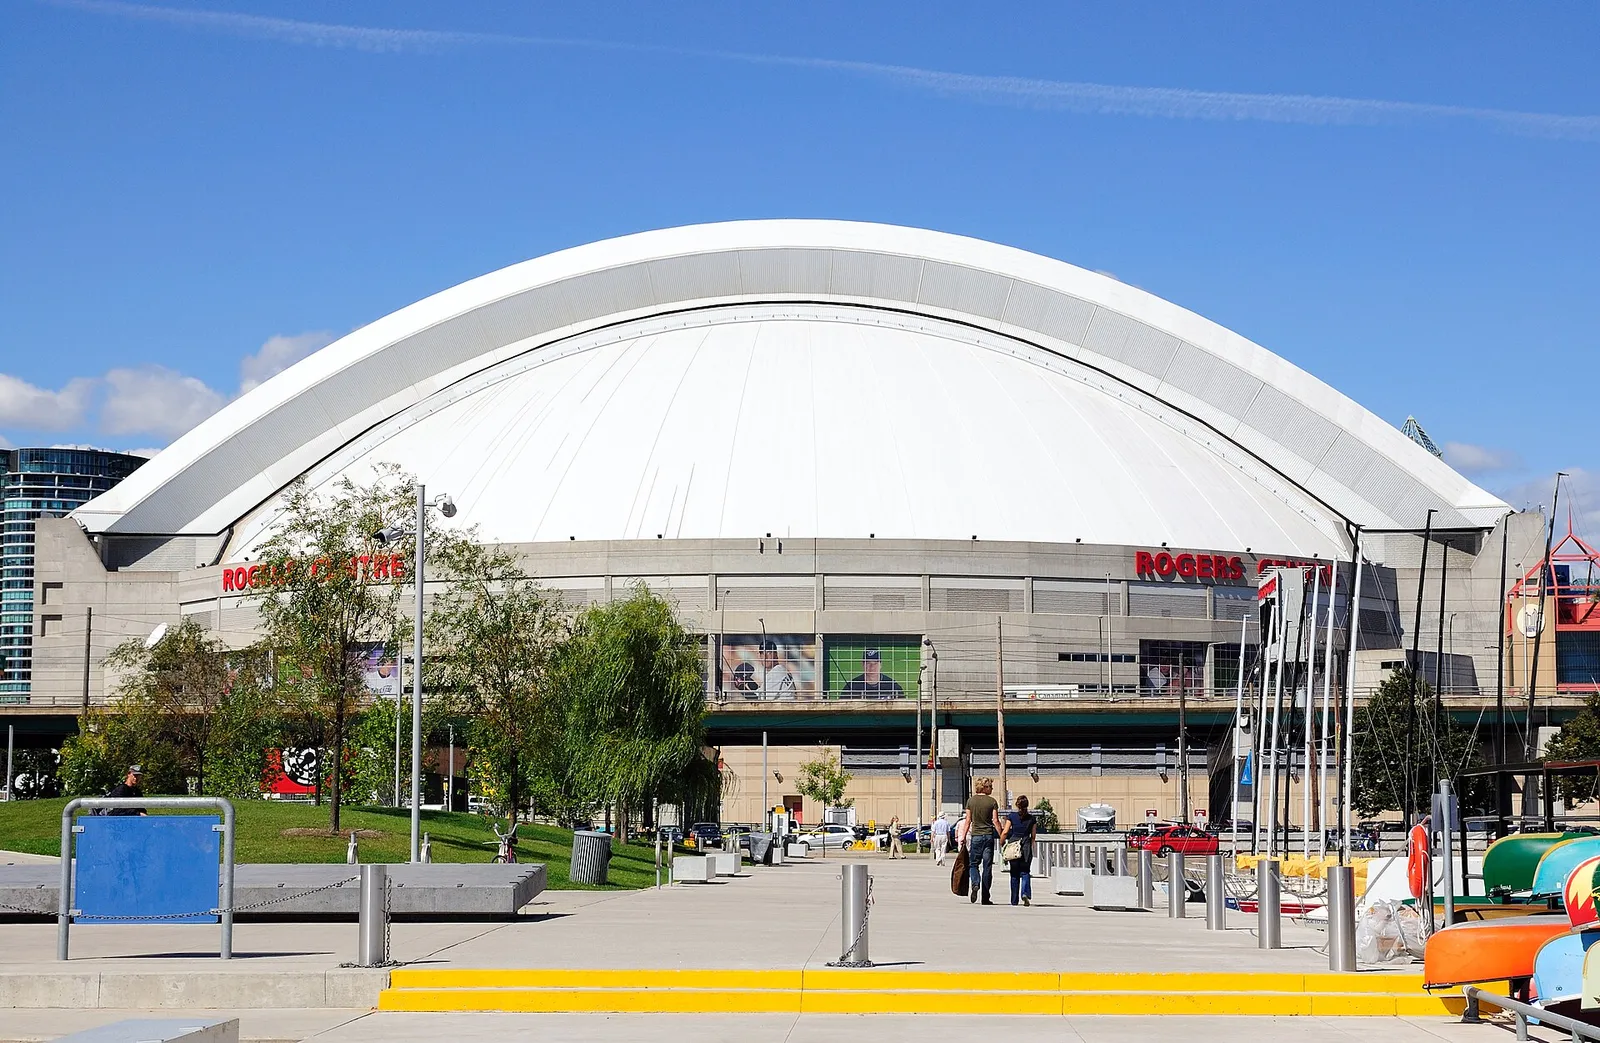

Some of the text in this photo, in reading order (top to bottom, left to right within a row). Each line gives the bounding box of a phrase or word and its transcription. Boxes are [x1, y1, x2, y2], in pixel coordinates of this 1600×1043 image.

[223, 553, 405, 592] ROG CTRE
[1135, 551, 1243, 579] ROGERS
